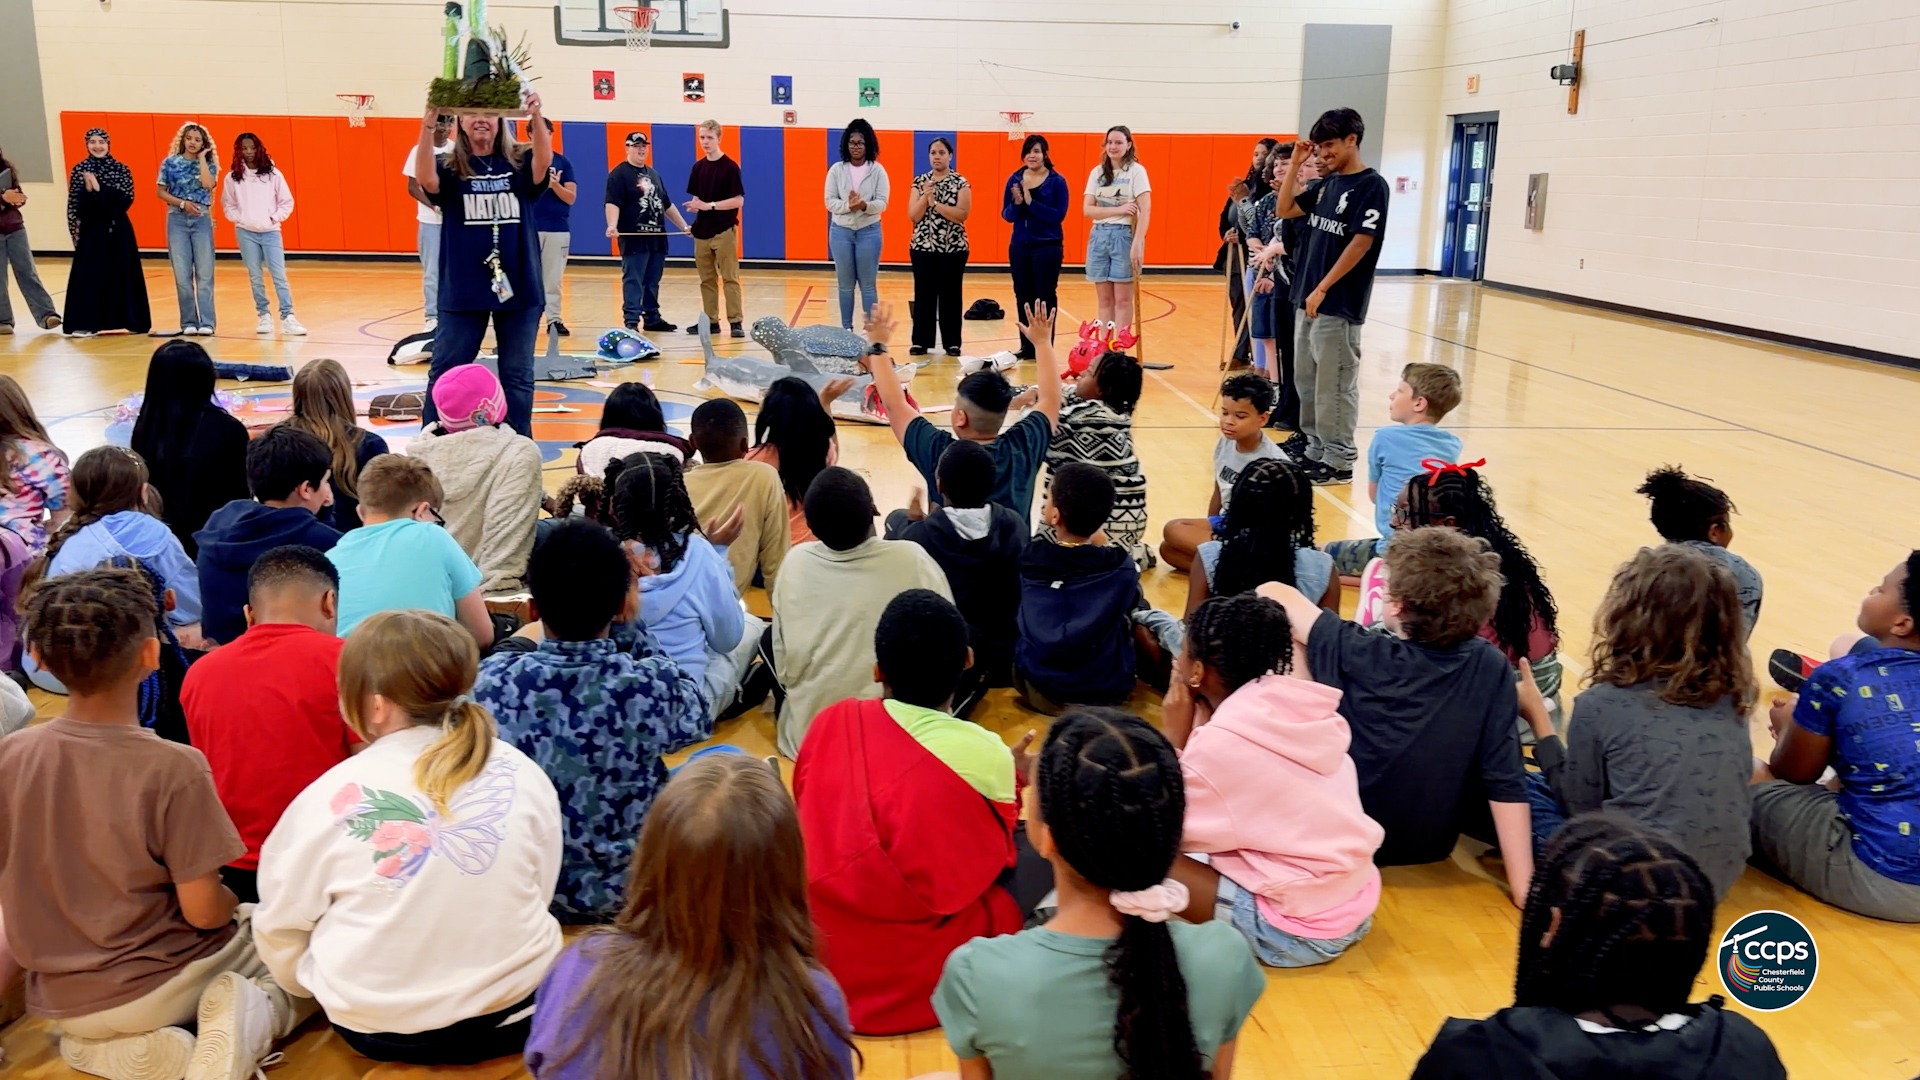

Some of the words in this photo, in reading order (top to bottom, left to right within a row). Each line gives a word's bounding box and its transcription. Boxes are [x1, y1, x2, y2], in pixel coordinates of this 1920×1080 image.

[463, 192, 521, 220] NATION
[1318, 217, 1348, 236] YORK
[1362, 208, 1381, 230] 2
